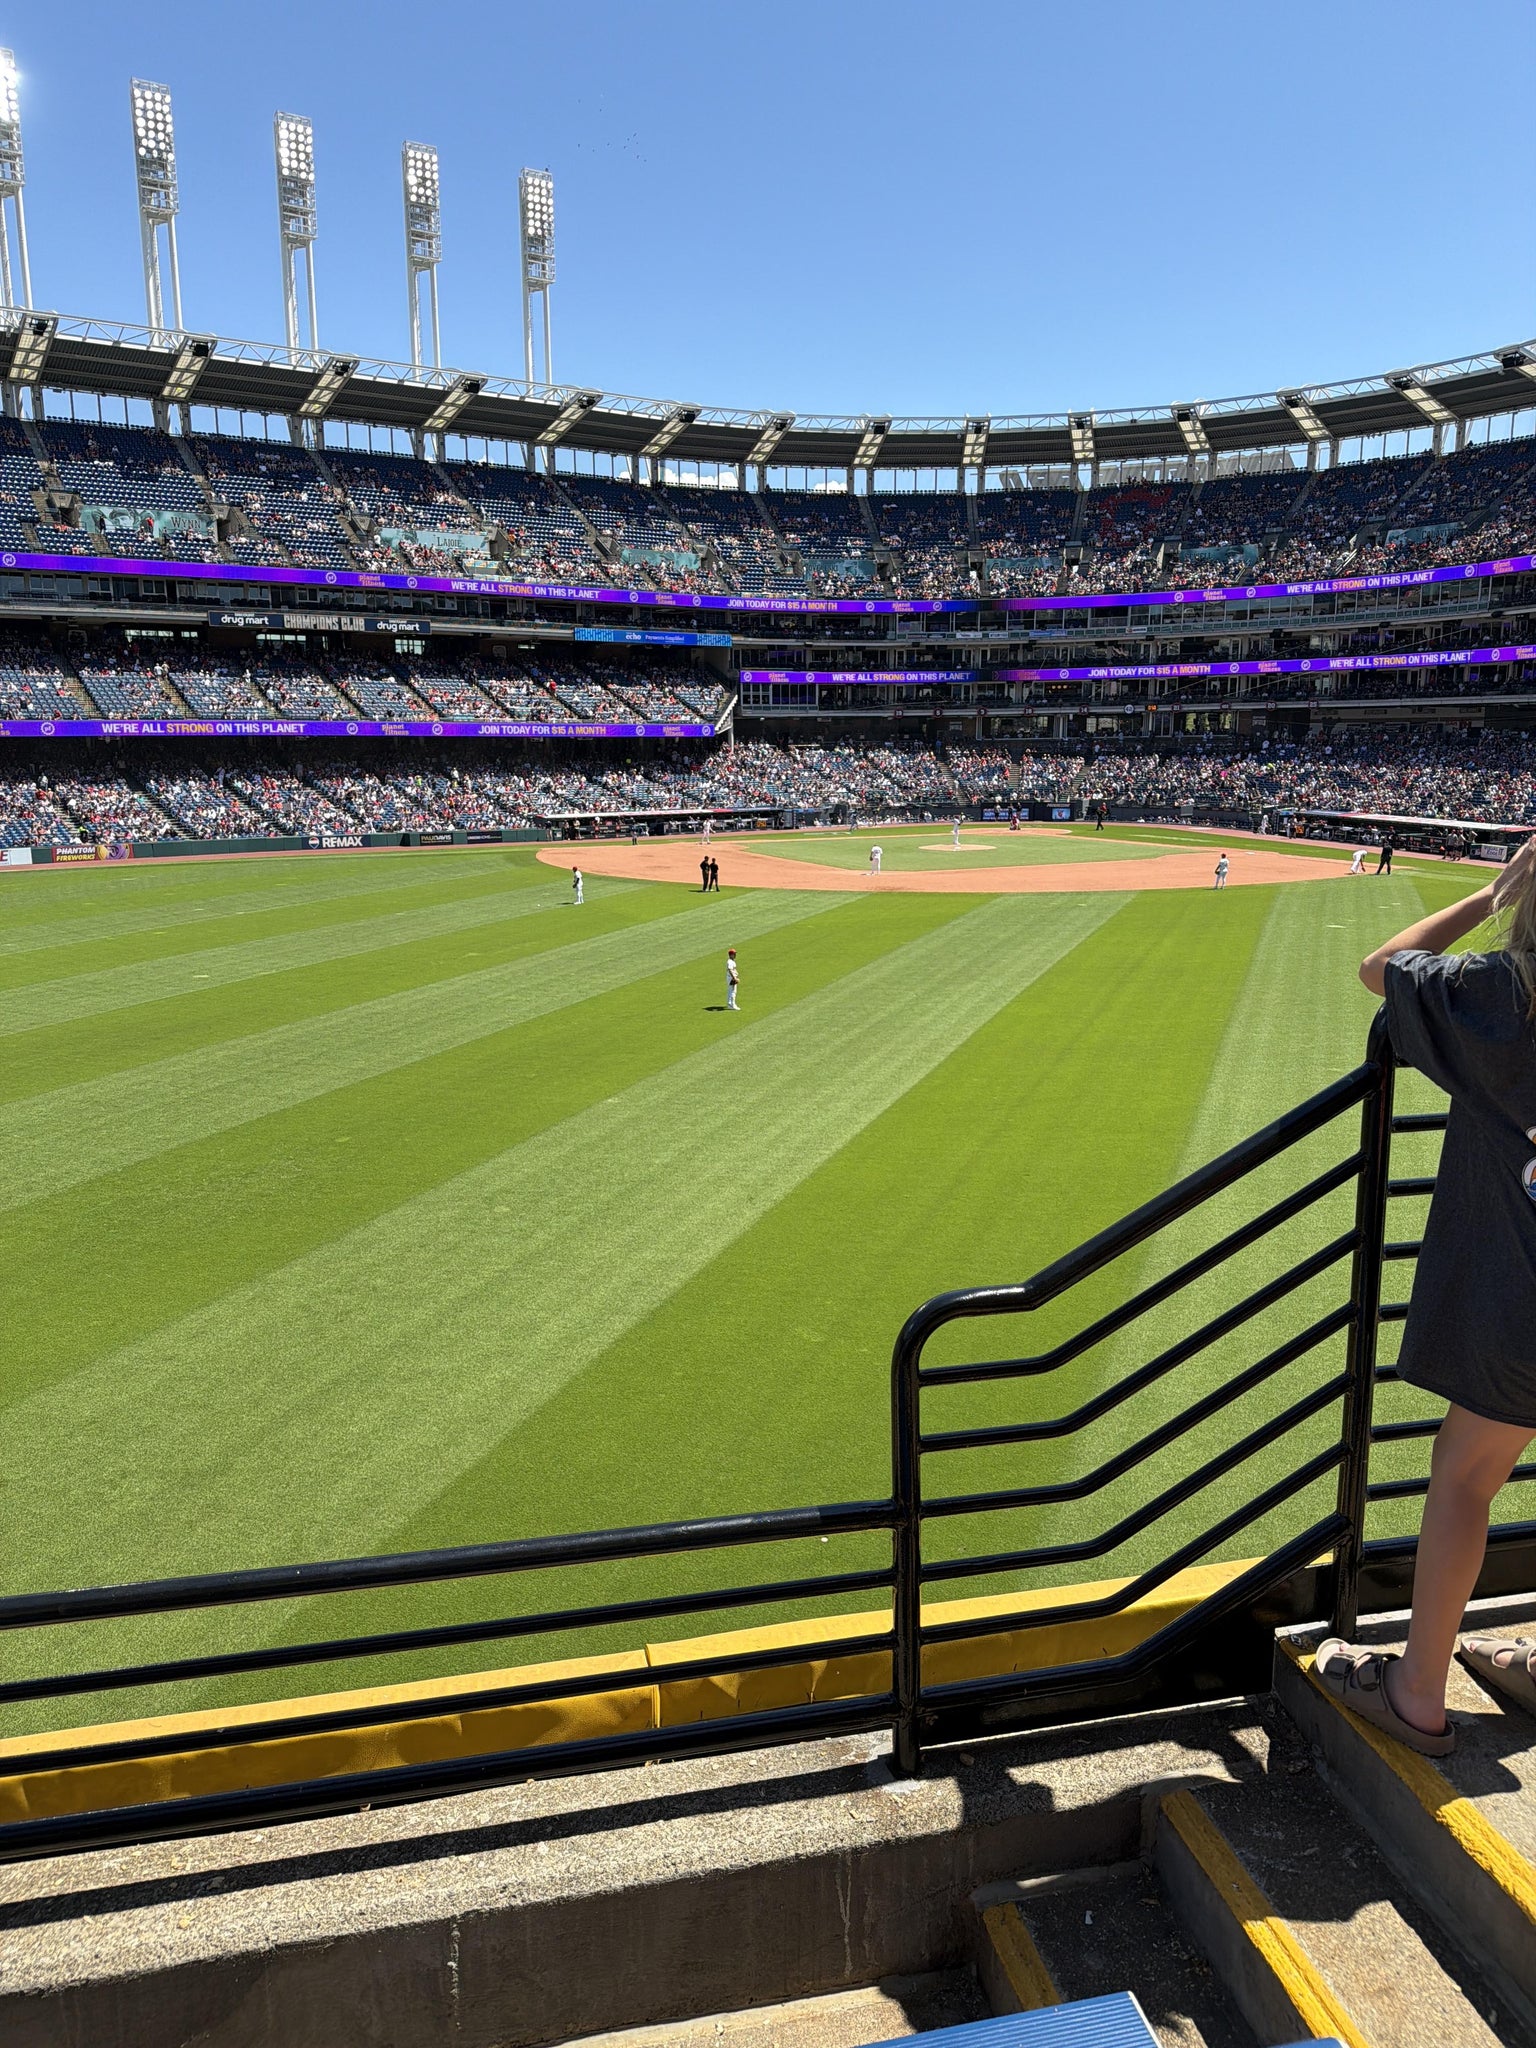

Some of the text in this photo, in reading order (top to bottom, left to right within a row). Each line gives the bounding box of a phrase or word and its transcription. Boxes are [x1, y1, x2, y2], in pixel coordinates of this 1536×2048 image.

[171, 516, 200, 529] WYNN
[437, 536, 462, 547] LAJOIE
[1287, 571, 1434, 593] WE'RE ALL STRONG ON THIS PLANET
[451, 581, 600, 599] WE'RE ALL STRONG ON THIS PLANET
[728, 599, 838, 610] JOIN TODAY FOR $15 A MONTH
[221, 615, 269, 626] drug mart
[283, 614, 365, 631] CHAMPIONS CLUB
[377, 621, 398, 632] drug
[398, 622, 420, 631] mart
[625, 632, 641, 640] echo
[1329, 652, 1474, 668] WE'RE ALL STRONG ON THIS PLANET
[832, 672, 970, 681] WE'RE ALL STRONG ON THIS PLANET
[1088, 665, 1211, 677] JOIN TODAY FOR $15 A MONTH
[102, 723, 306, 733] WE'RE ALL STRONG ON THIS PLANET
[478, 725, 606, 735] JOIN TODAY FOR $15 A MONTH
[56, 846, 95, 855] PHANTOM
[56, 854, 95, 862] FIREWORKS
